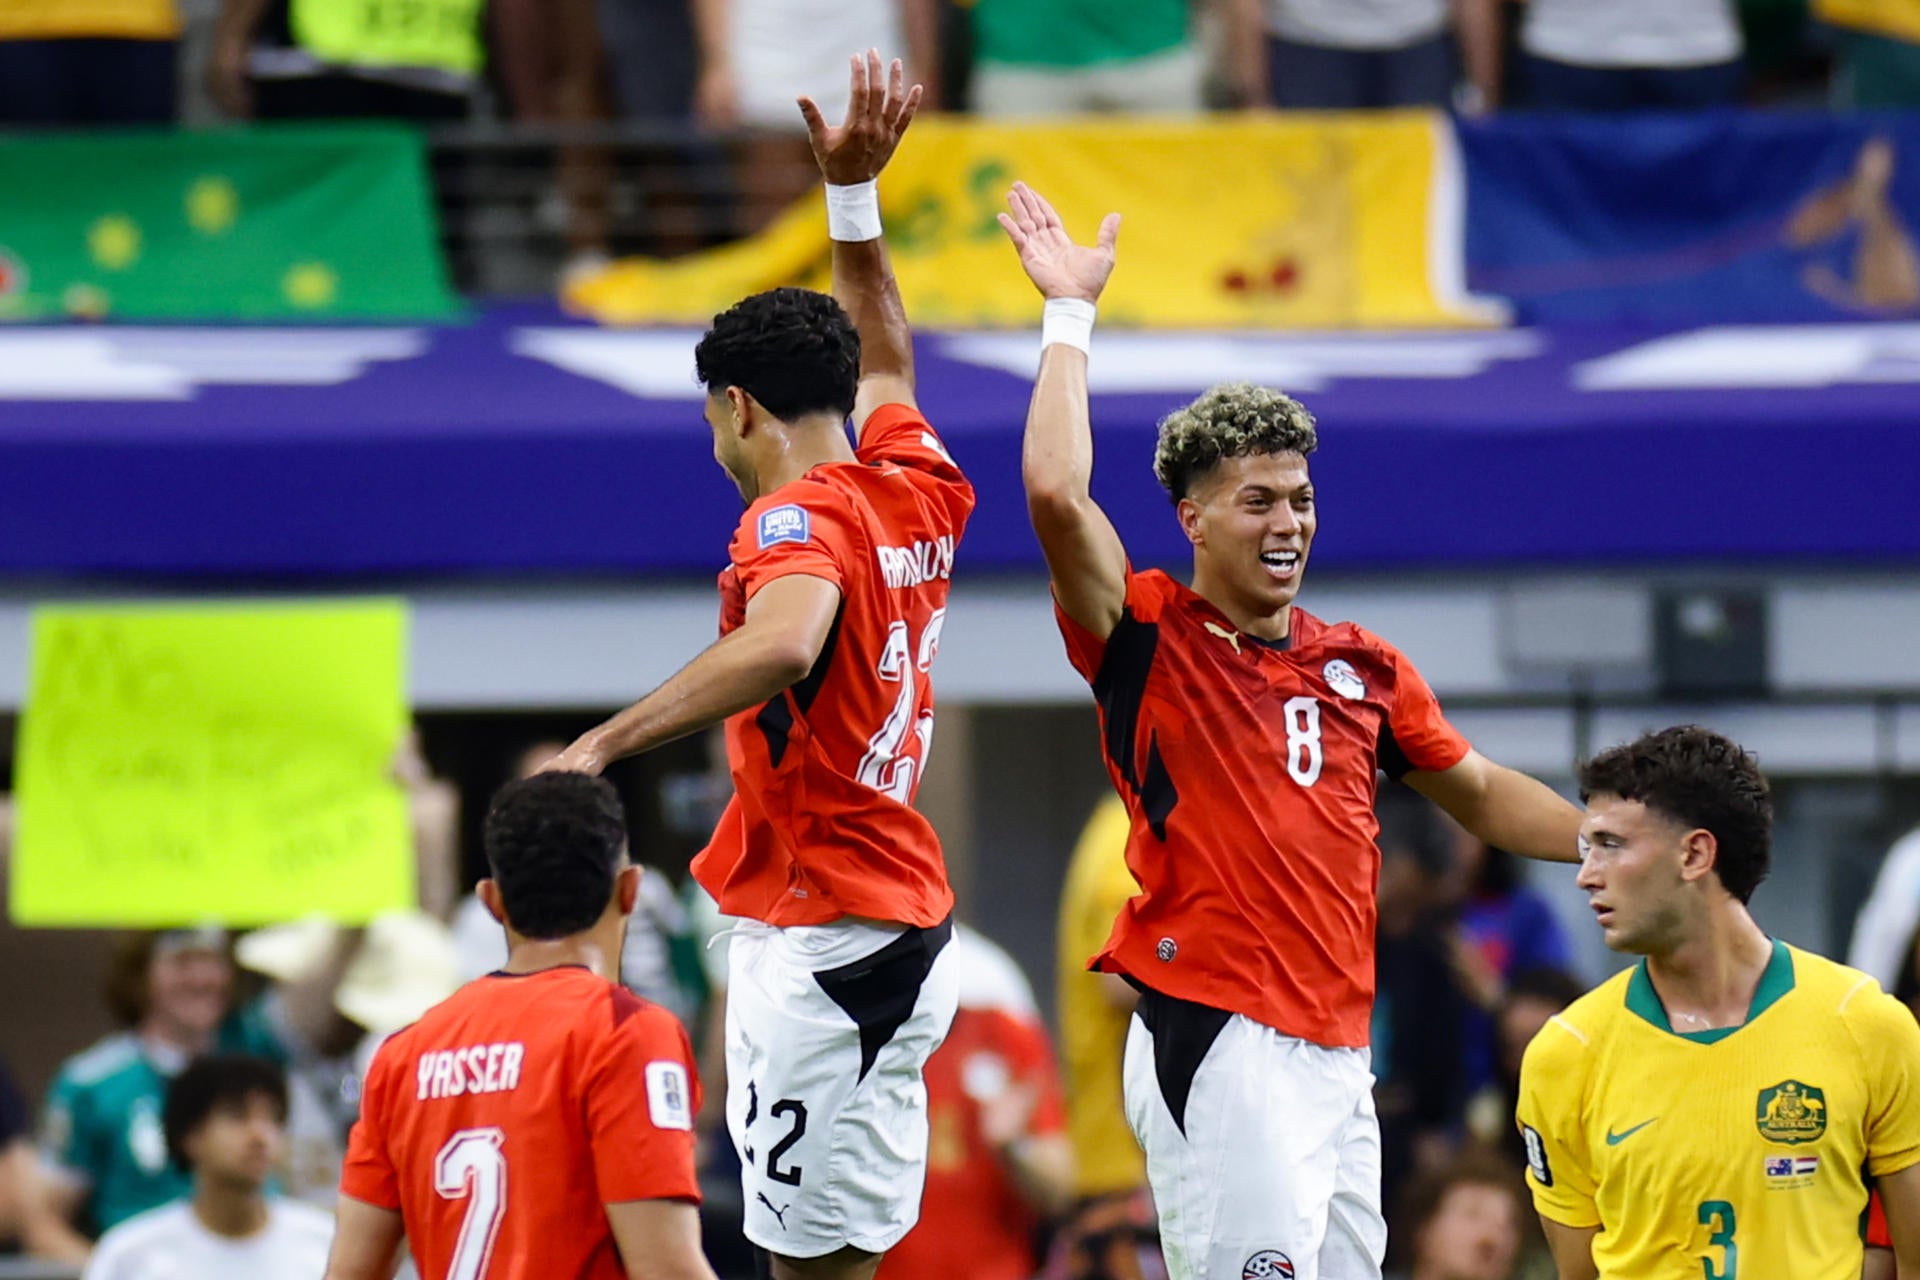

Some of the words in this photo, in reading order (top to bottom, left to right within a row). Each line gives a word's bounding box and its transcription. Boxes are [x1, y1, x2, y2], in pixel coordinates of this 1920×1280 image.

[1282, 695, 1324, 788] 8
[416, 1041, 525, 1101] YASSER
[1697, 1200, 1738, 1280] 3
